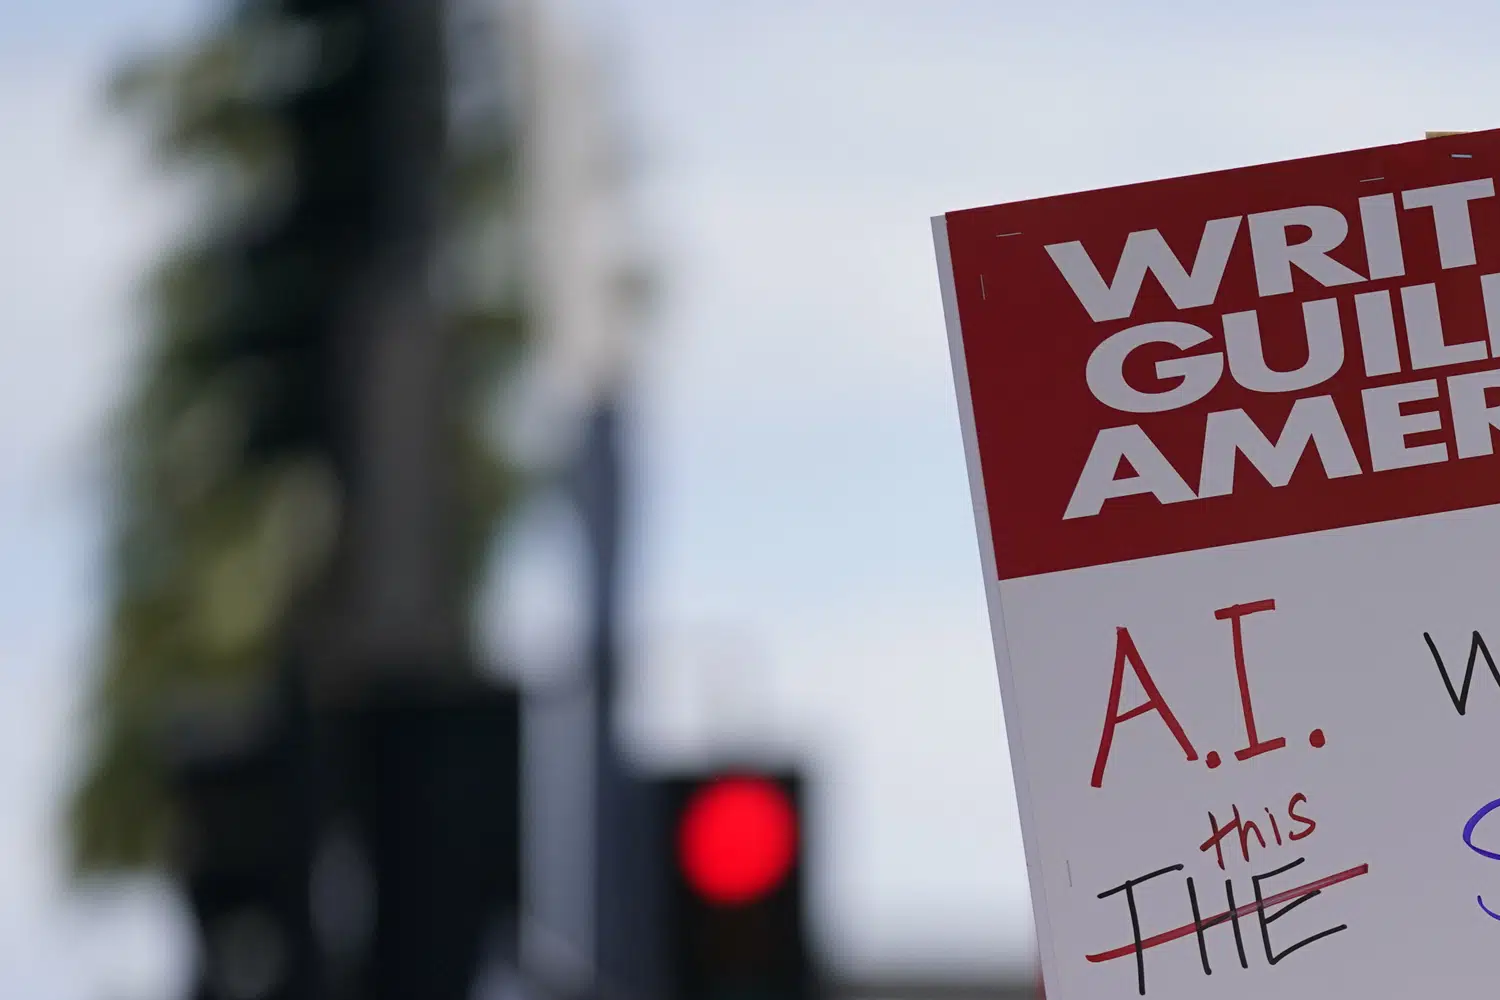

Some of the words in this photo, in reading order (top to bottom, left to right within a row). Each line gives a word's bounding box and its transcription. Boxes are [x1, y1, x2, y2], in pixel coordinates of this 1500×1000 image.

[1090, 598, 1326, 788] A.I.
[1200, 792, 1317, 869] this
[1096, 857, 1348, 995] THE
